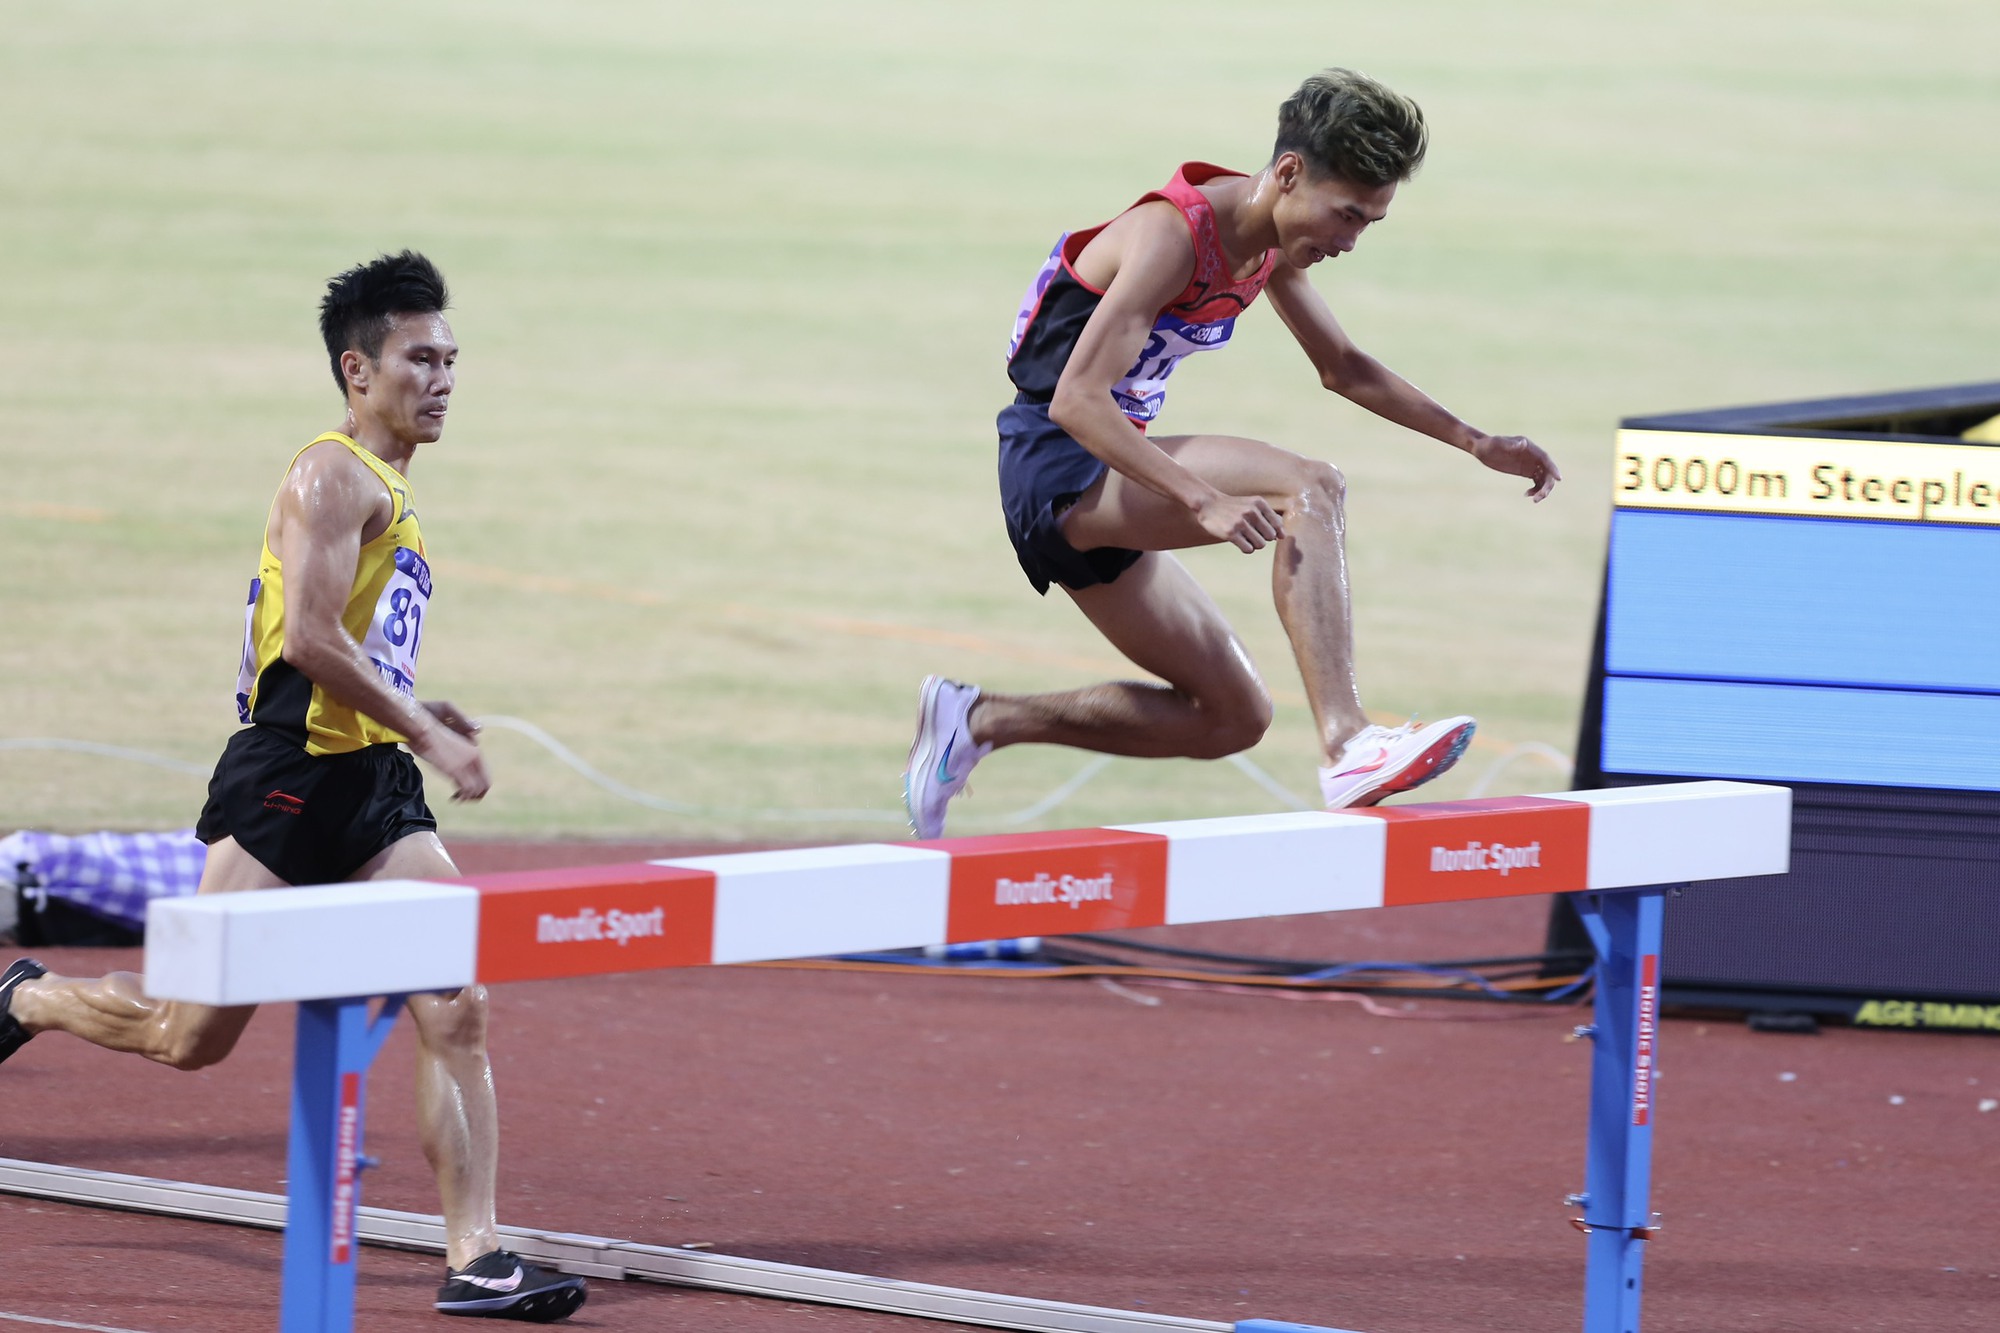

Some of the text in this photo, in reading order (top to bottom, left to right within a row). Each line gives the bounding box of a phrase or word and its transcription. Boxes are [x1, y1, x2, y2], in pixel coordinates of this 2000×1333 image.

[1623, 455, 2000, 520] 3000m Steeple
[1489, 841, 1541, 876] Sport
[1058, 872, 1113, 909] Sport
[605, 906, 664, 946] Sport
